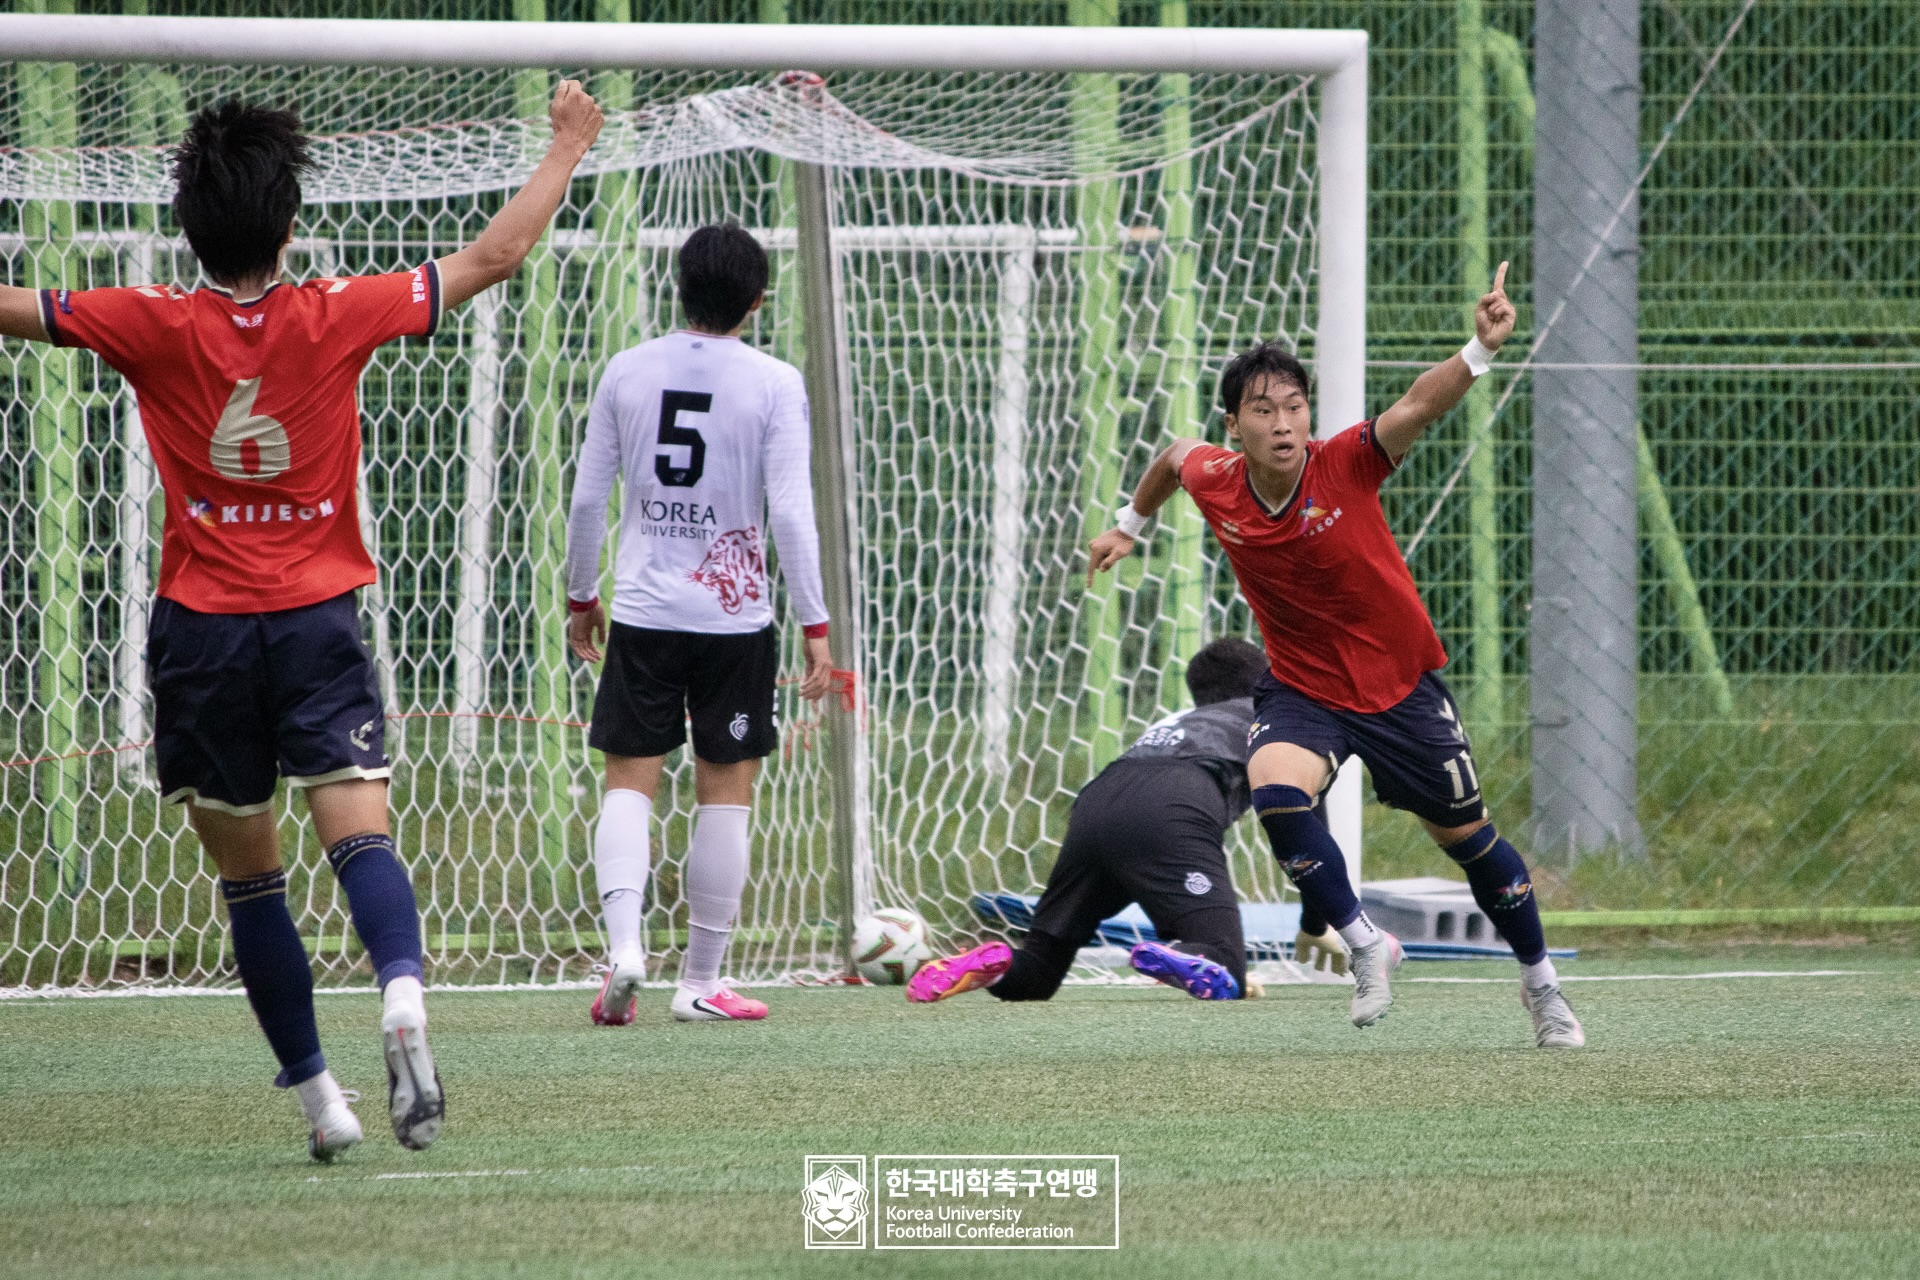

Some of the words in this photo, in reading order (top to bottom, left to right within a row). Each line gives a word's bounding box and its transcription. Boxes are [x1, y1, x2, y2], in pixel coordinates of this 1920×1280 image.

[209, 375, 291, 483] 6
[654, 388, 713, 488] 5
[221, 498, 334, 523] KIJEON
[641, 499, 717, 525] KOREA
[1443, 749, 1479, 799] 11
